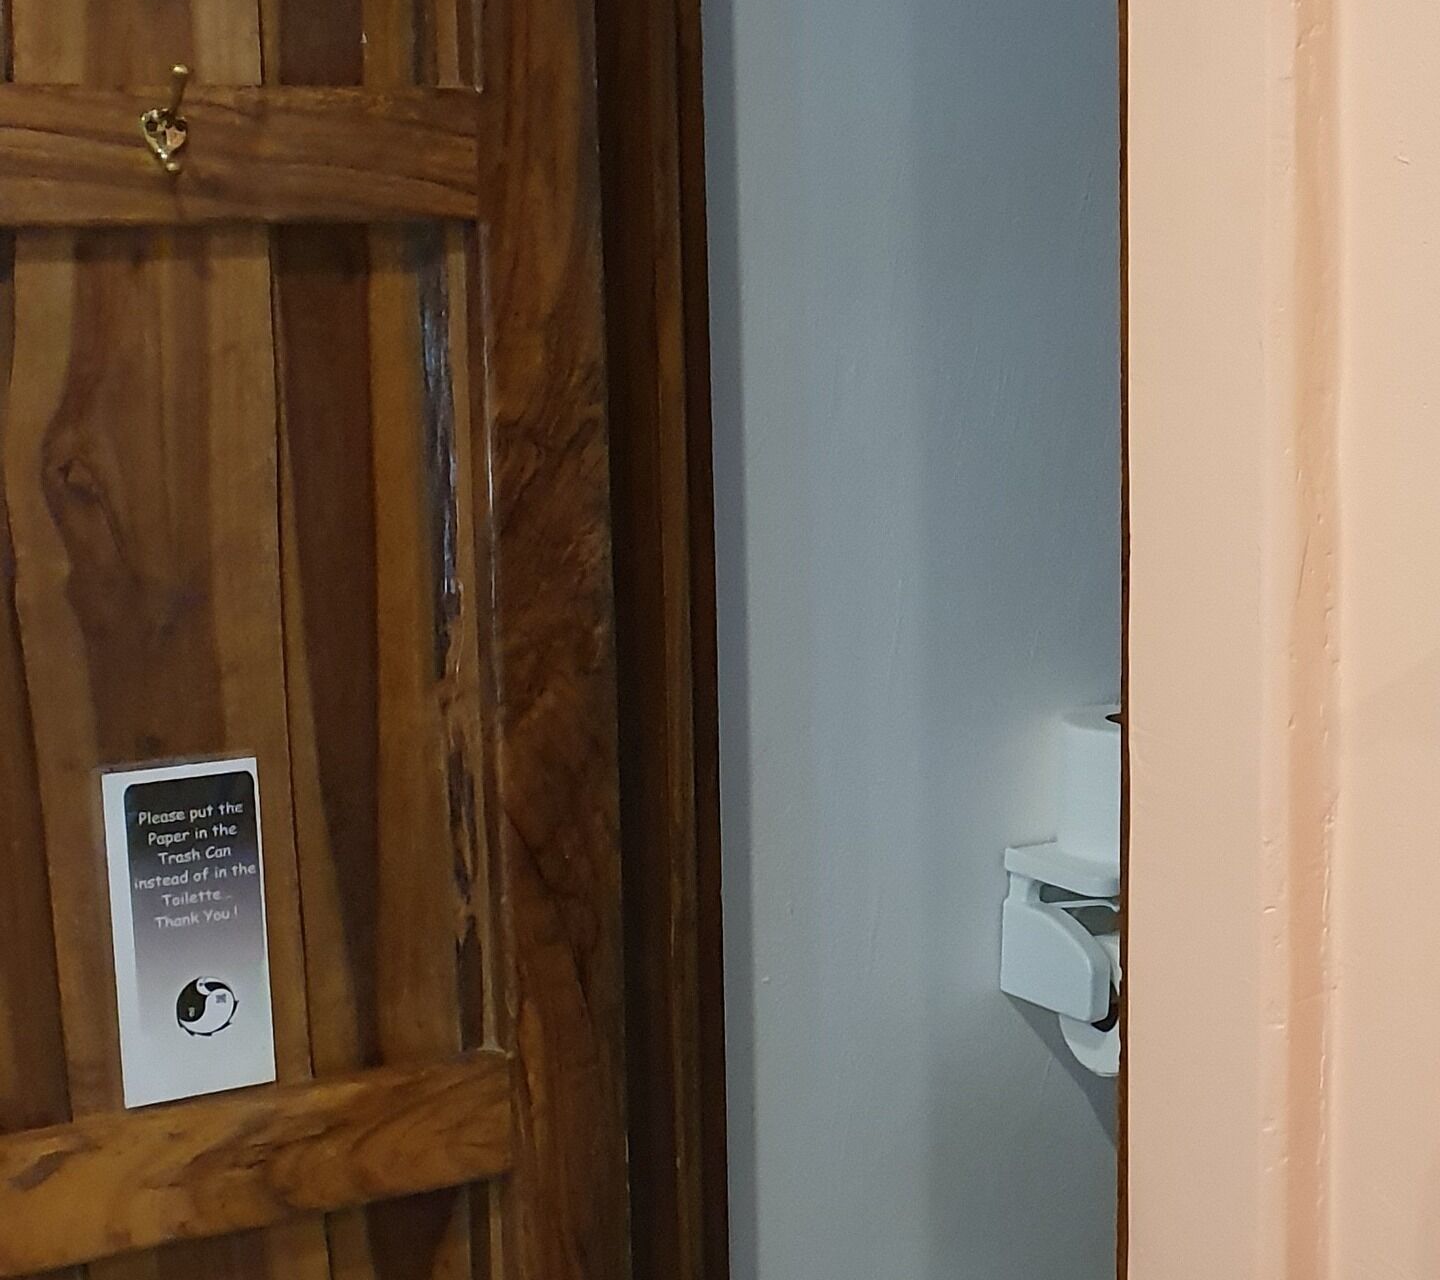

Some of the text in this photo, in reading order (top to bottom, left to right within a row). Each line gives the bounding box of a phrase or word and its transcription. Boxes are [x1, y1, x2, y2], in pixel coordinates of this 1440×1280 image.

[138, 801, 243, 826] Please put the
[148, 822, 238, 847] Paper in the
[157, 845, 232, 865] Trash Can
[134, 862, 257, 890] instead of in the
[154, 911, 200, 929] Thank
